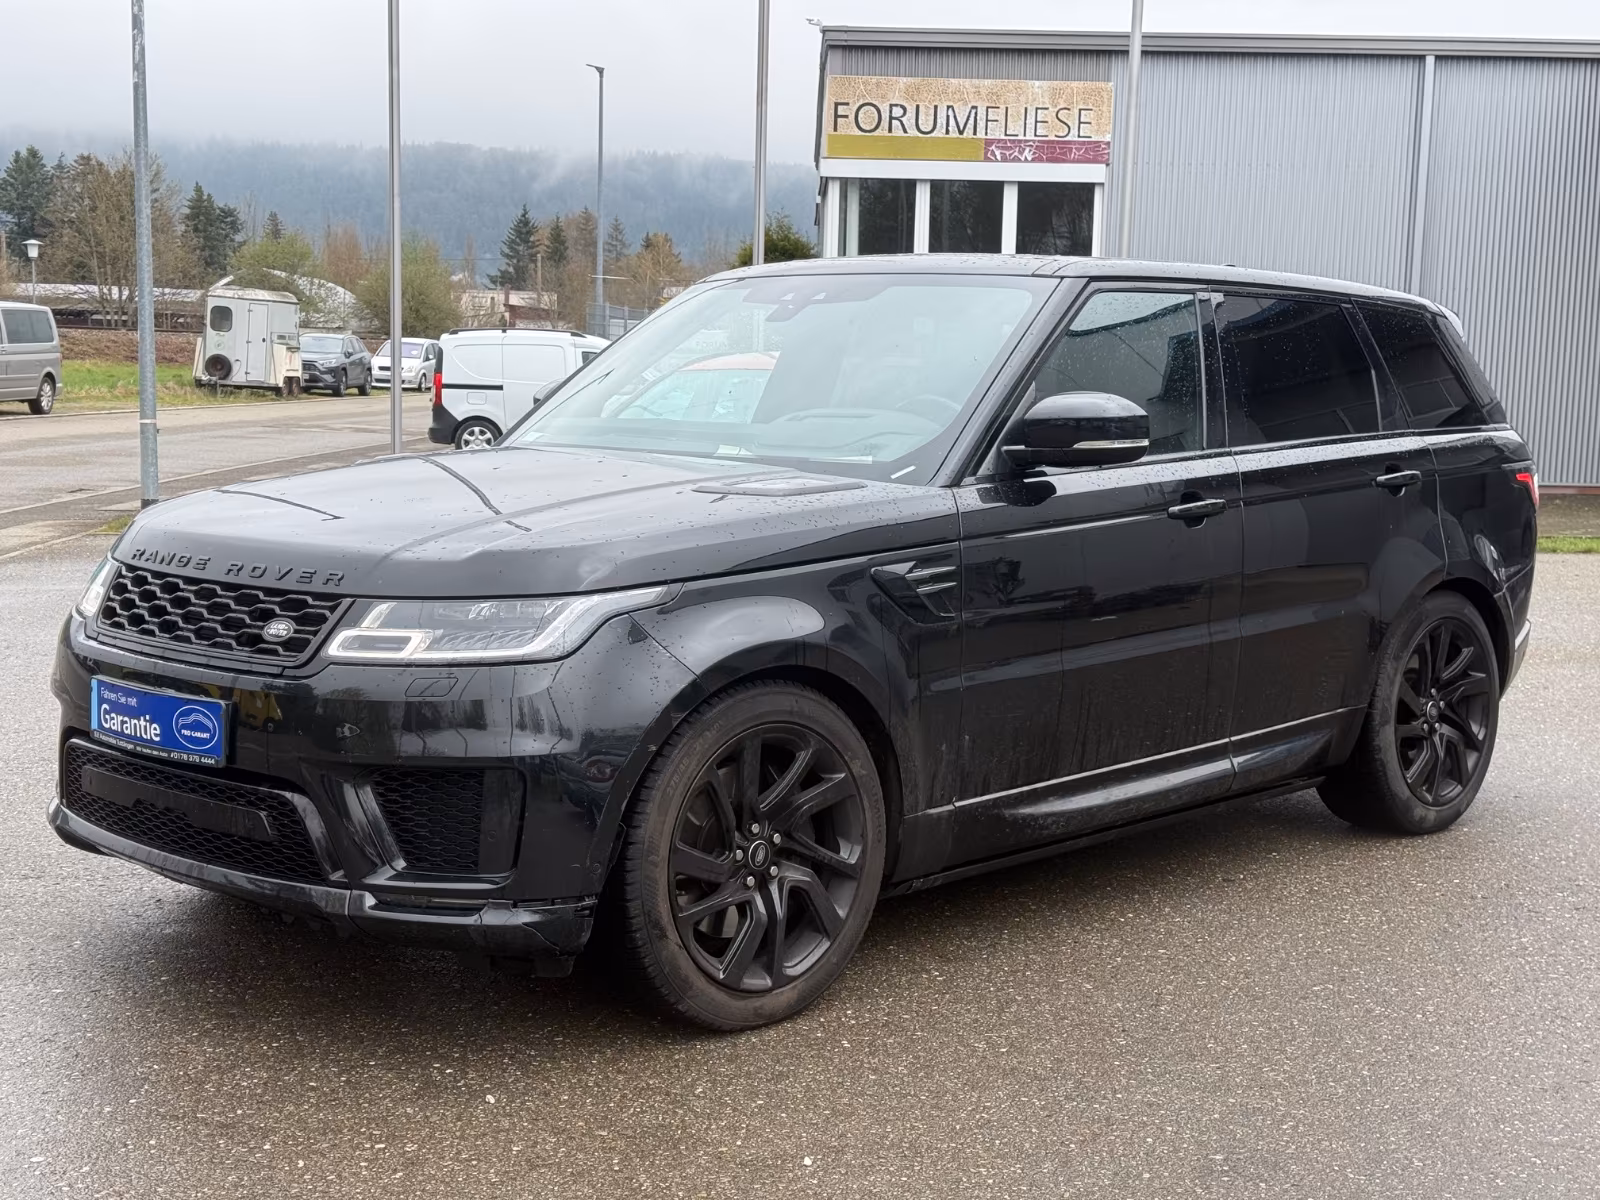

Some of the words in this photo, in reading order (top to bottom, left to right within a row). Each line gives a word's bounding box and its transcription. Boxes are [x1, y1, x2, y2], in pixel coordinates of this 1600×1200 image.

[131, 548, 211, 570] RANGE
[224, 560, 345, 586] ROVER
[100, 687, 117, 701] Fahren
[117, 692, 126, 703] Sie
[127, 696, 137, 707] mit
[100, 703, 160, 741] Garantie
